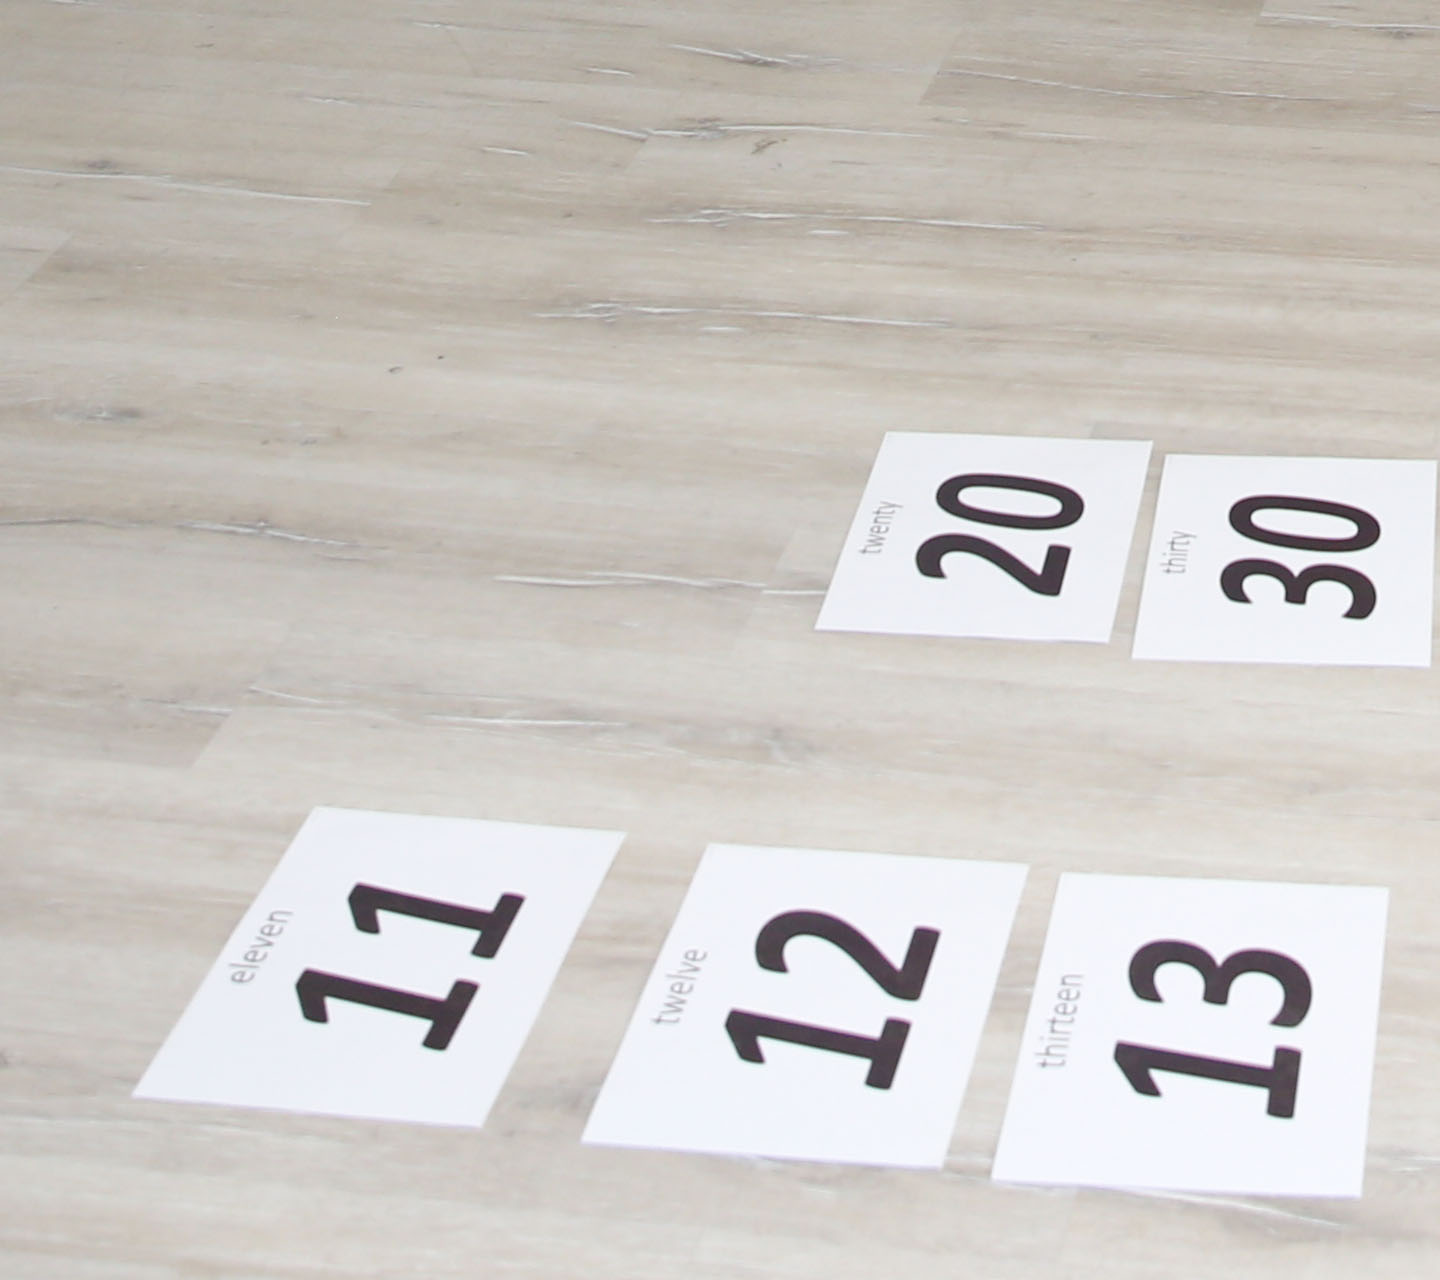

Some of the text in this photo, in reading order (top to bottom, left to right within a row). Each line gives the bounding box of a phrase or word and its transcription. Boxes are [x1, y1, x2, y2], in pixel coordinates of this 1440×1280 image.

[860, 500, 903, 554] twenty
[915, 472, 1085, 597] 20
[1160, 529, 1197, 574] thirty
[1220, 495, 1381, 620] 30
[229, 909, 293, 985] eleven
[295, 882, 526, 1052] 11
[651, 947, 708, 1026] twelve
[725, 908, 941, 1090] 12
[1034, 973, 1084, 1070] thirteen
[1113, 938, 1313, 1120] 13
